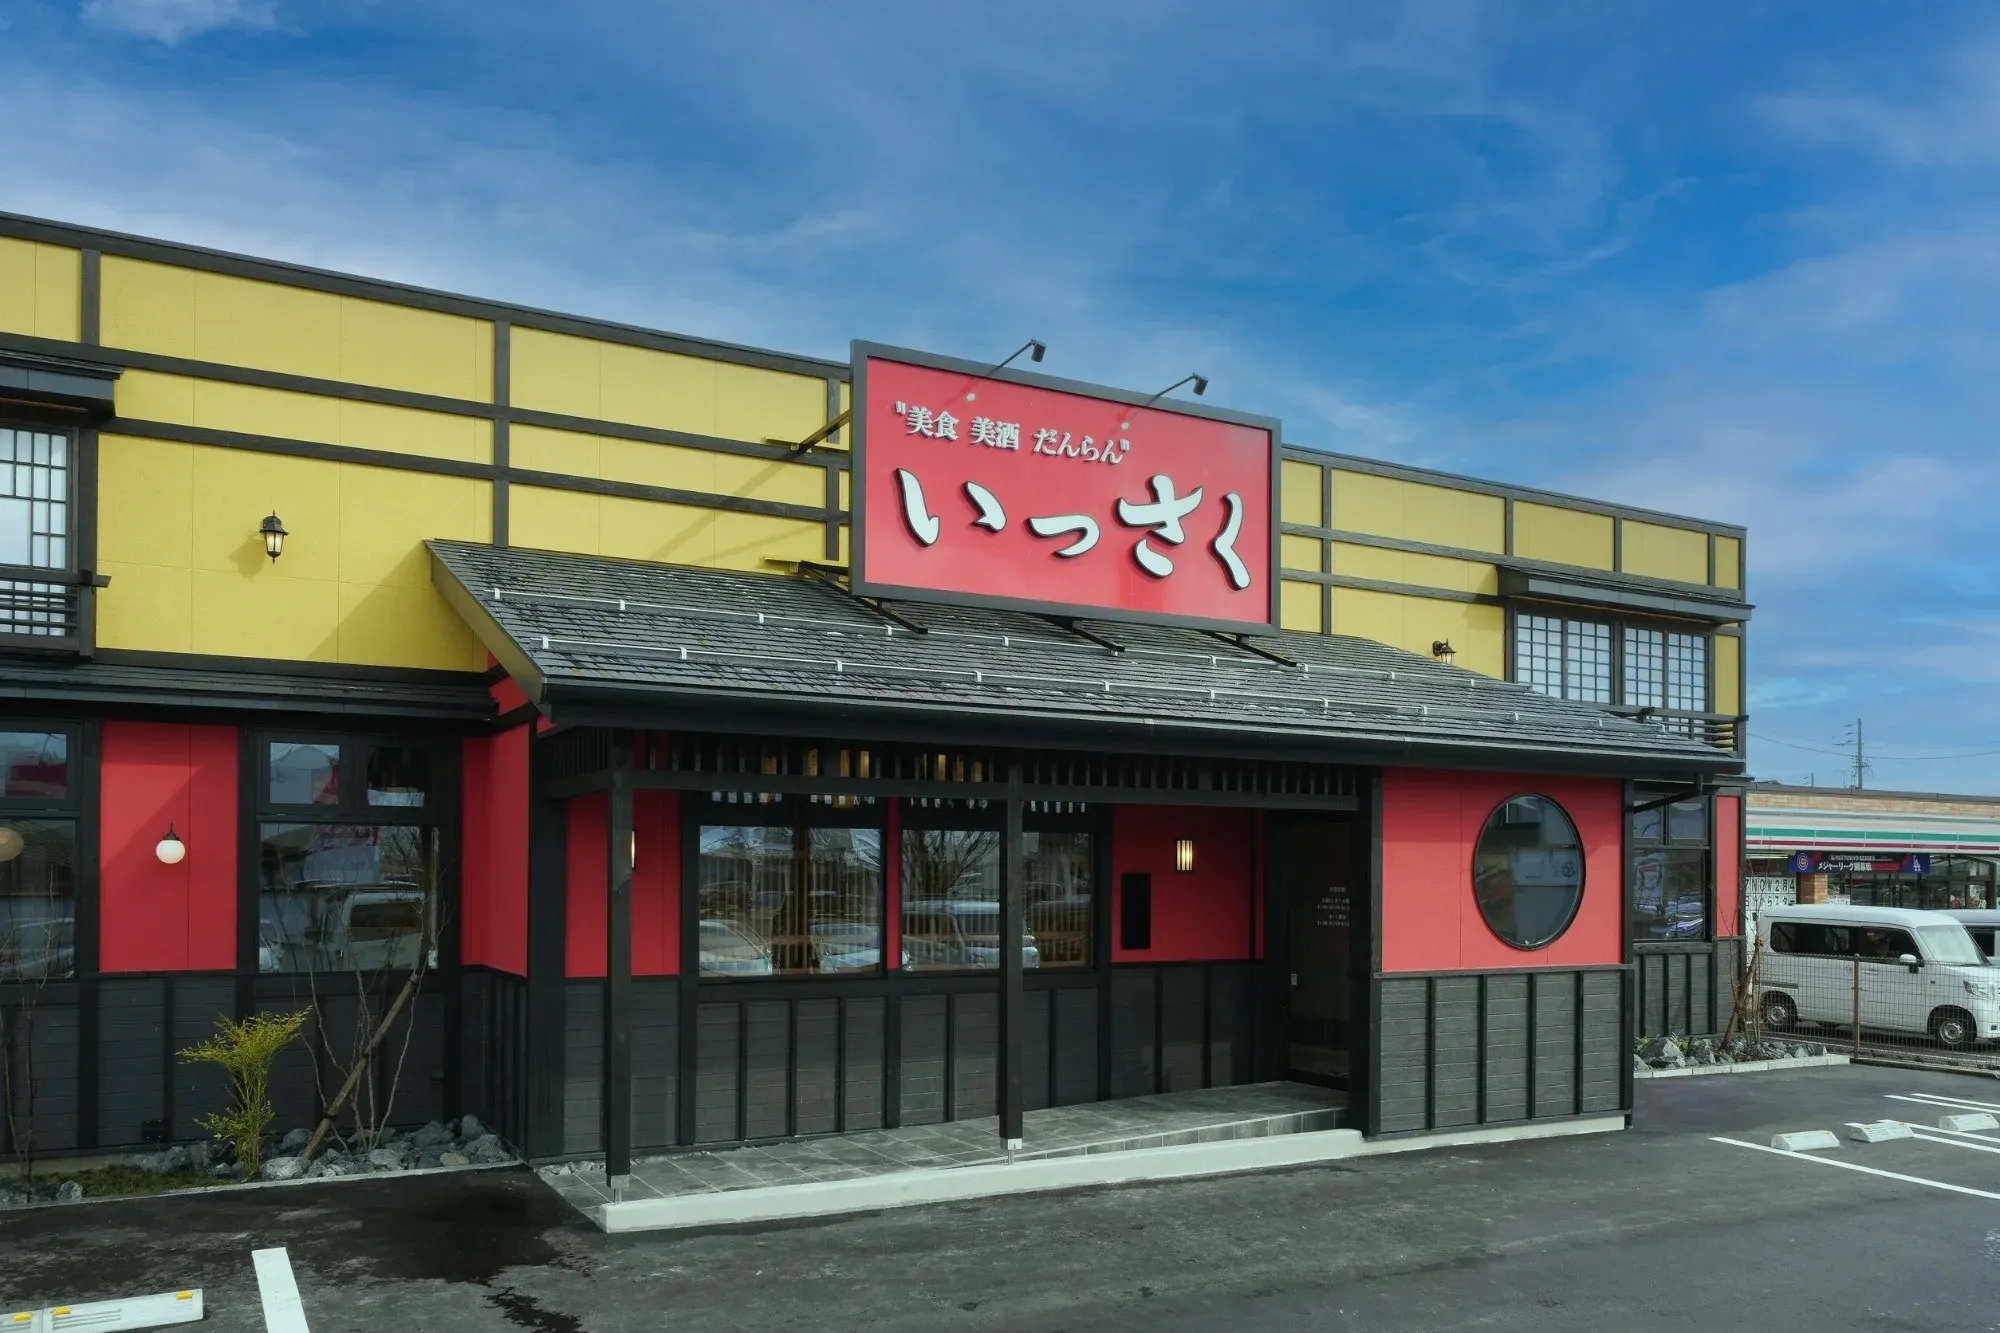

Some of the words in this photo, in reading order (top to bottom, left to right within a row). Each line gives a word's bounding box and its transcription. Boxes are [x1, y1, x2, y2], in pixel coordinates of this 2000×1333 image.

[969, 416, 1020, 451] 美酒
[896, 467, 1251, 590] いっさく
